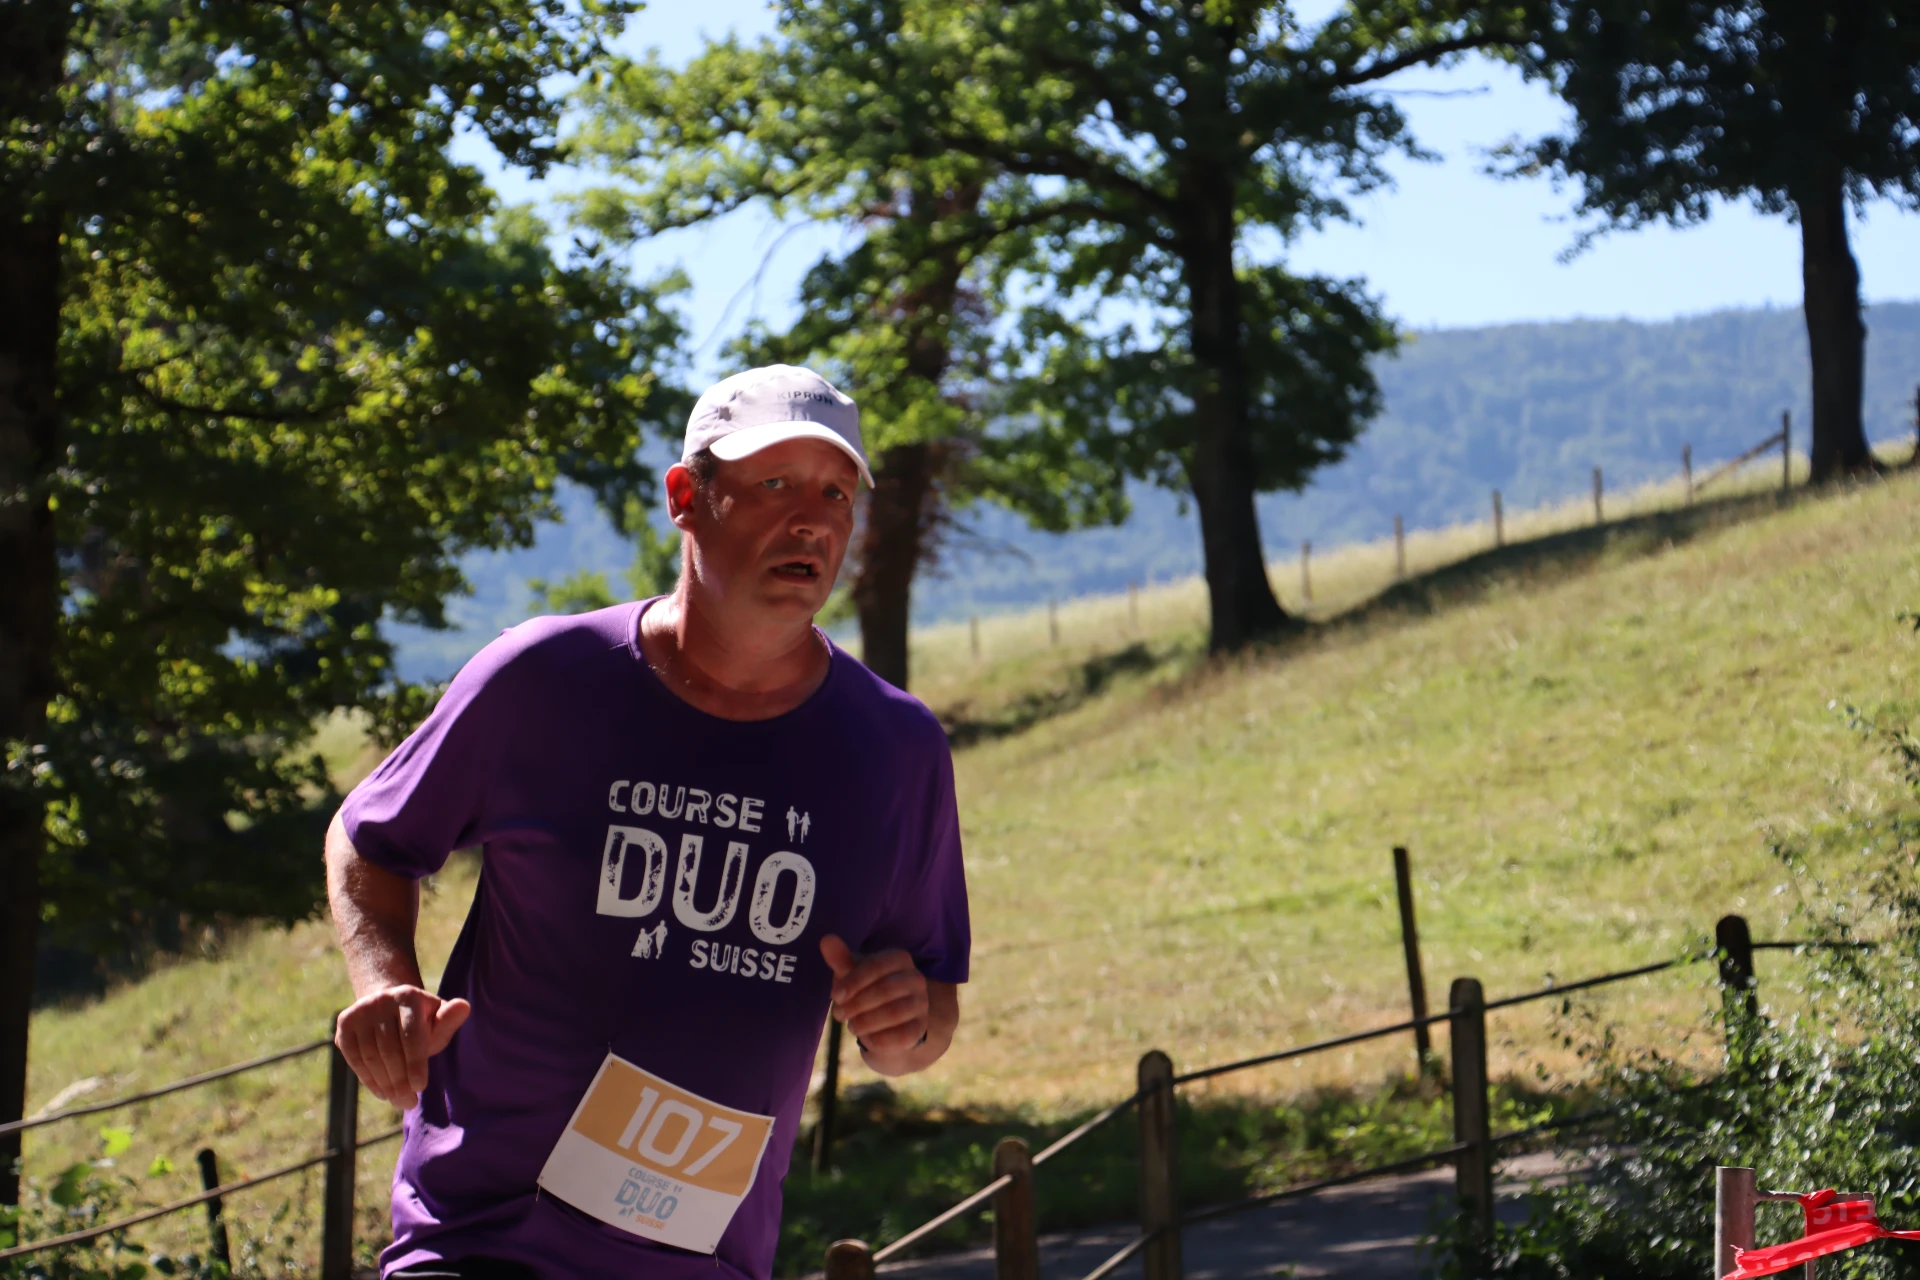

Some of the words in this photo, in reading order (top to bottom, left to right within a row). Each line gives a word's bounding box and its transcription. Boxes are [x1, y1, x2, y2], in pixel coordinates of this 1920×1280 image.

[777, 391, 833, 405] KIPRUN
[608, 780, 765, 833] COURSE
[596, 824, 816, 945] DUO
[689, 939, 798, 984] SUISSE
[616, 1086, 743, 1177] 107
[614, 1178, 678, 1220] DUO
[628, 1167, 671, 1191] COURSE
[635, 1214, 665, 1230] SUISSE
